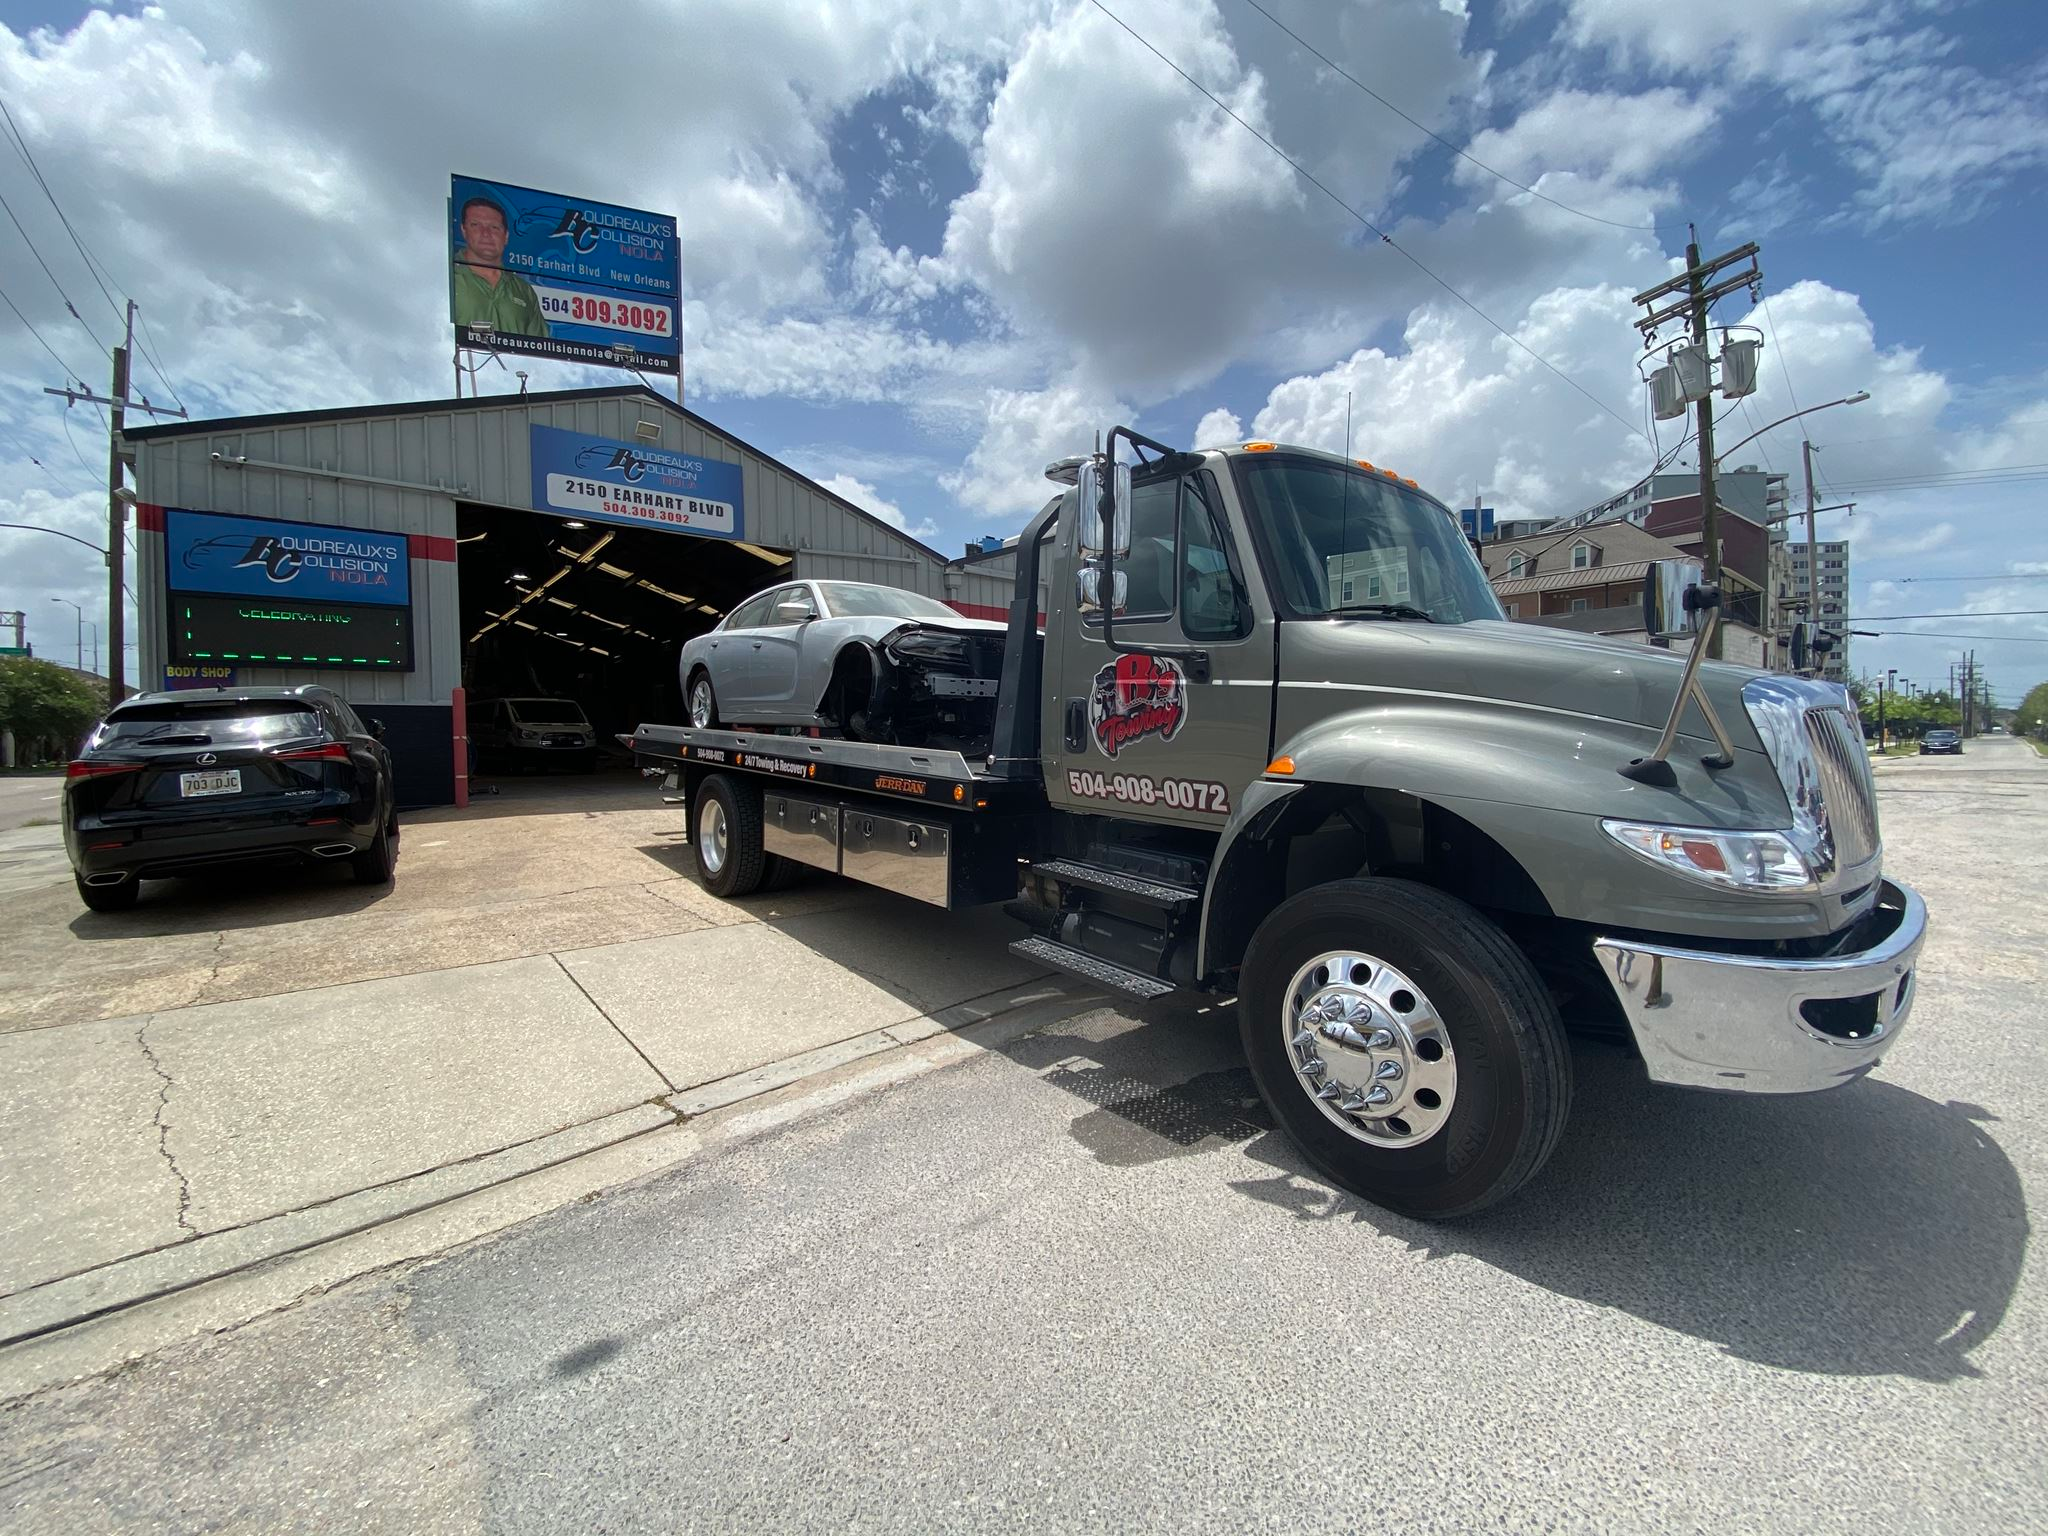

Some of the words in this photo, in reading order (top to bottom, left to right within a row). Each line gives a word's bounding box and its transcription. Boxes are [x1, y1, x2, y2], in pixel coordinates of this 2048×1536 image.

[619, 244, 663, 262] NOLA
[509, 252, 534, 267] 2150
[537, 256, 575, 274] Earhart
[579, 263, 601, 278] Blvd
[610, 269, 631, 282] New
[634, 273, 671, 290] Orleans
[541, 296, 569, 314] 504
[572, 296, 667, 333] 309.3092
[565, 479, 607, 498] 2150
[613, 488, 683, 511] EARHART
[689, 501, 724, 518] BLVD
[602, 501, 690, 525] 504.309.3092
[329, 568, 388, 586] NOLA
[166, 666, 198, 678] BODY
[201, 666, 232, 678] SHOP
[1097, 706, 1180, 754] Towing
[744, 754, 756, 767] 24/7
[756, 755, 774, 772] Towing
[774, 758, 780, 770] &
[780, 759, 807, 778] Recovery
[185, 779, 208, 791] 703
[215, 777, 238, 789] DJC
[875, 776, 926, 795] JERR-DAN
[1067, 770, 1230, 814] 504-908-0072
